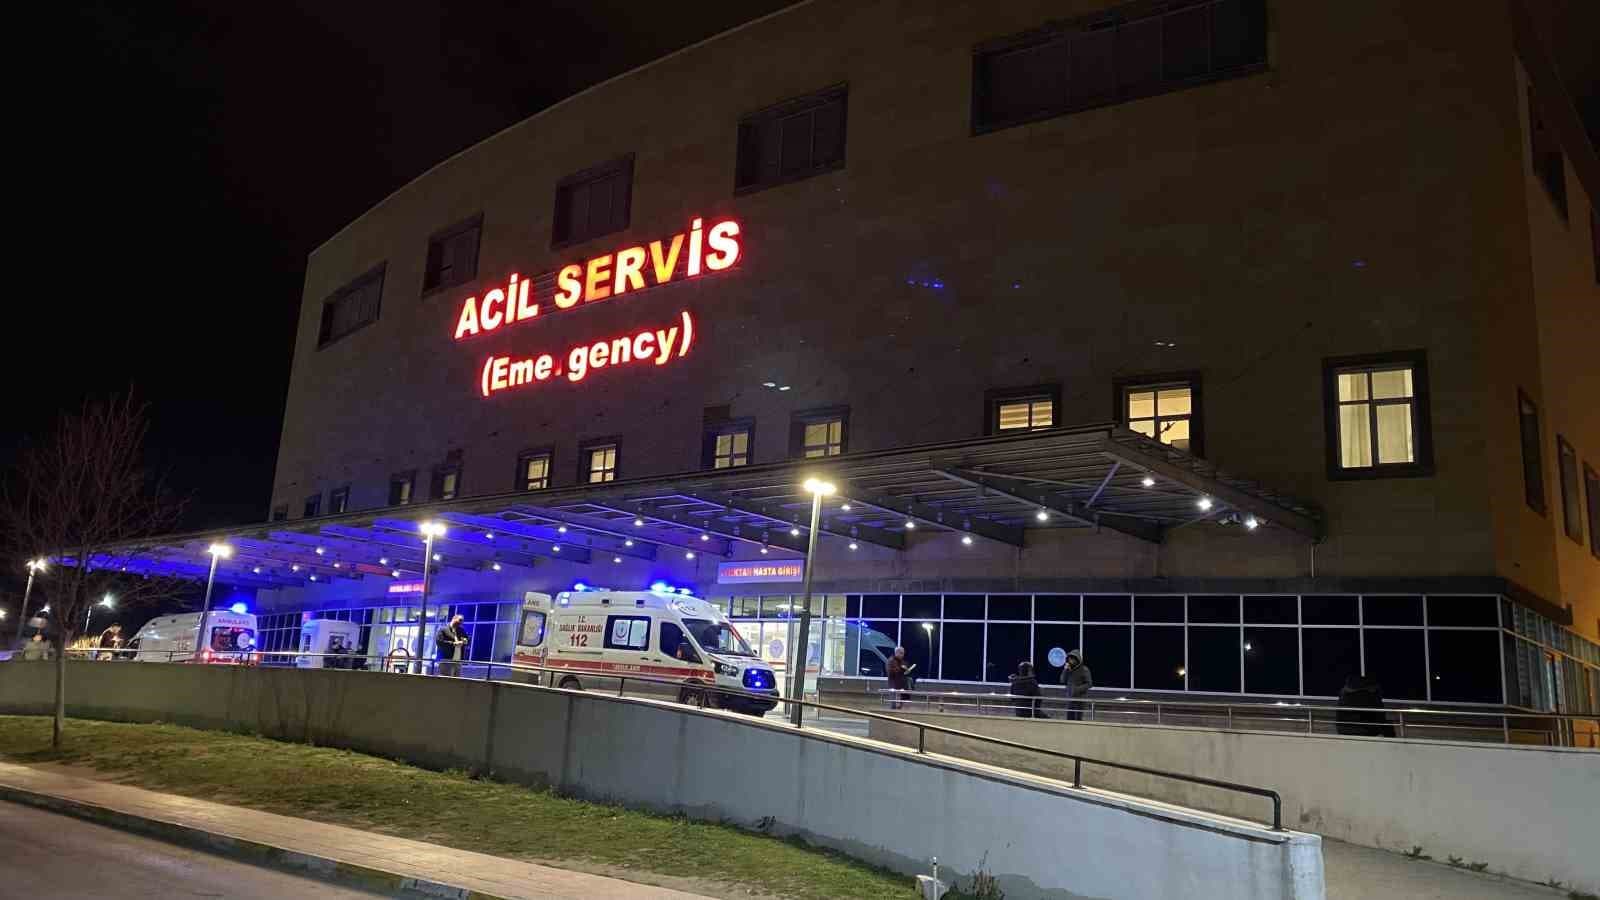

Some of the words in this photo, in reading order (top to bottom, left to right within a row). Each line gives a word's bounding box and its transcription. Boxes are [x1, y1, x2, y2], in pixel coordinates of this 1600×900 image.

[453, 272, 539, 339] ACİL
[553, 217, 741, 309] SERVİS
[481, 311, 693, 397] (Emegency)
[570, 633, 588, 647] 112
